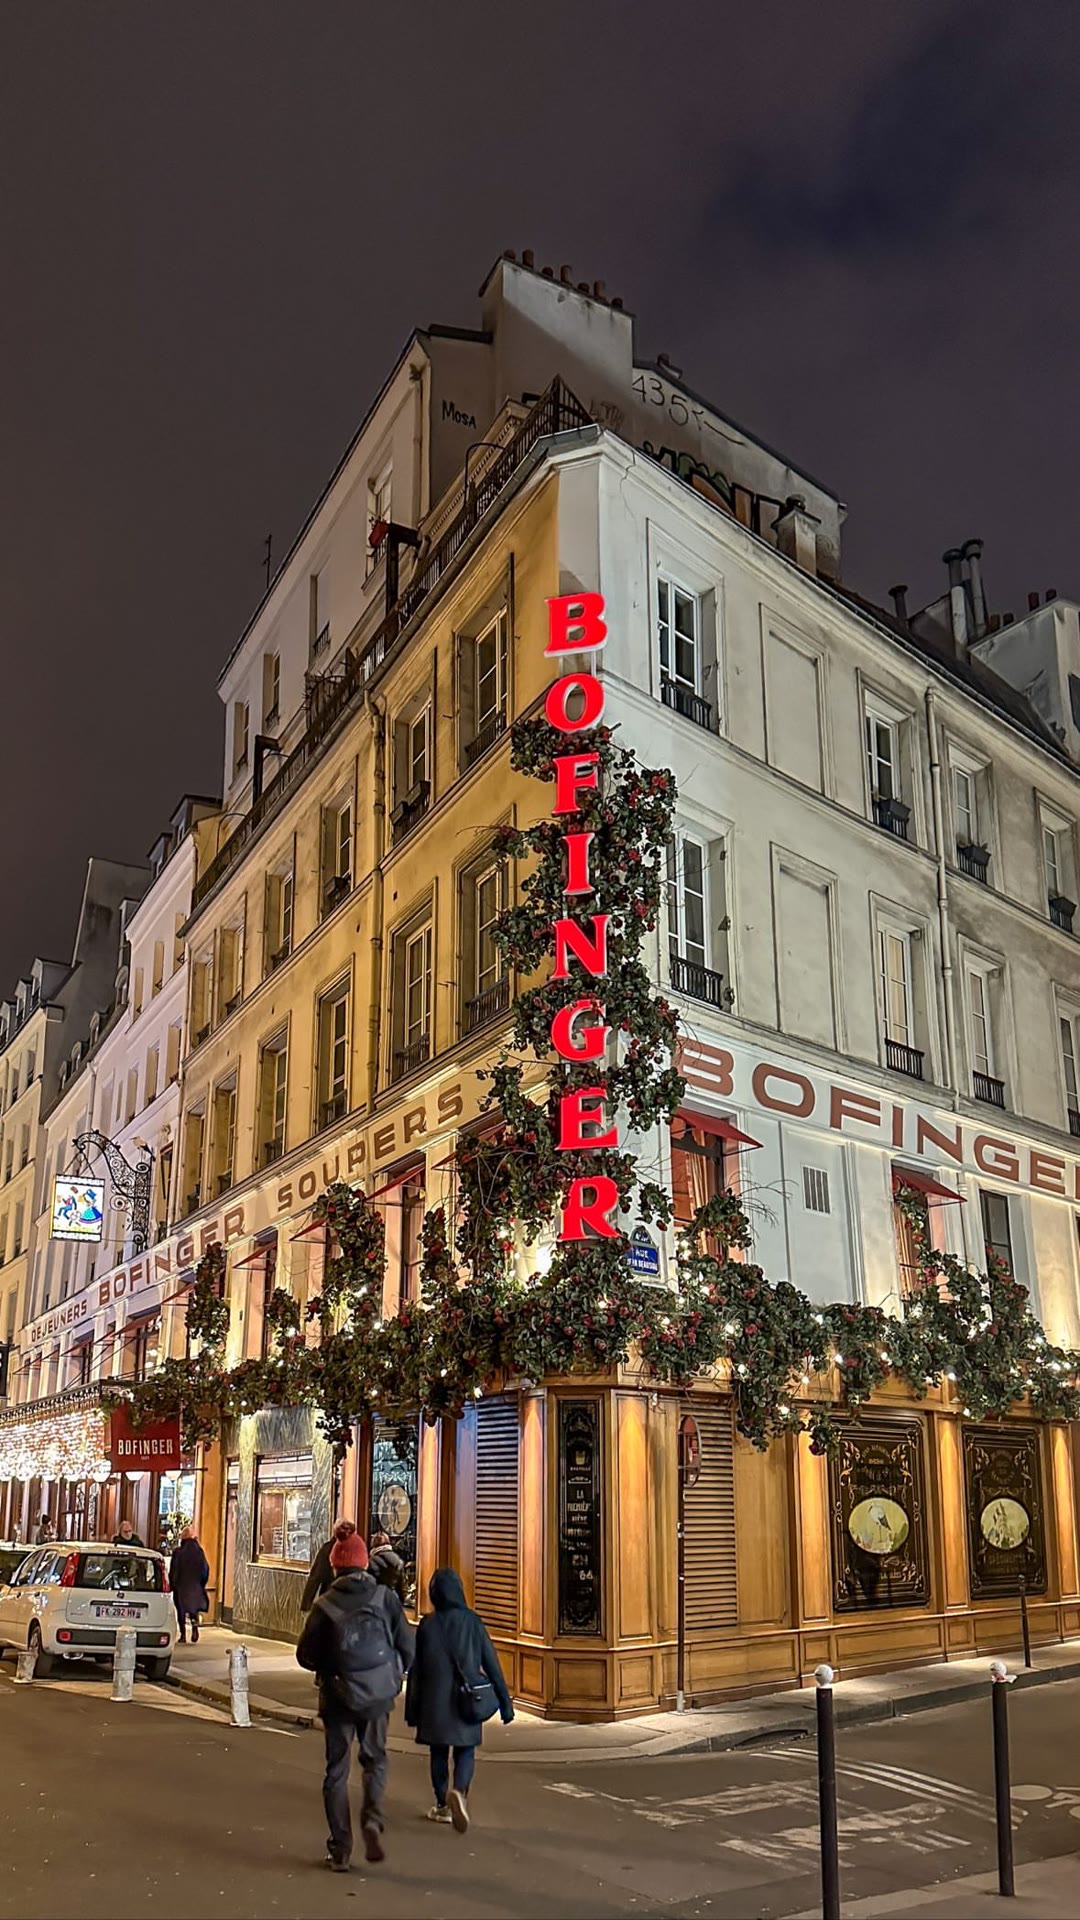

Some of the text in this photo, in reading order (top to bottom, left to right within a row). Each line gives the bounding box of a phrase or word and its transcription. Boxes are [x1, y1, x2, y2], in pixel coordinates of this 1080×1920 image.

[544, 591, 621, 1243] BOFINGER
[99, 1206, 246, 1306] BOFINGER
[277, 1083, 464, 1212] SOUPERS
[673, 1035, 1080, 1200] BOFINGE
[117, 1438, 174, 1456] BOFINGER
